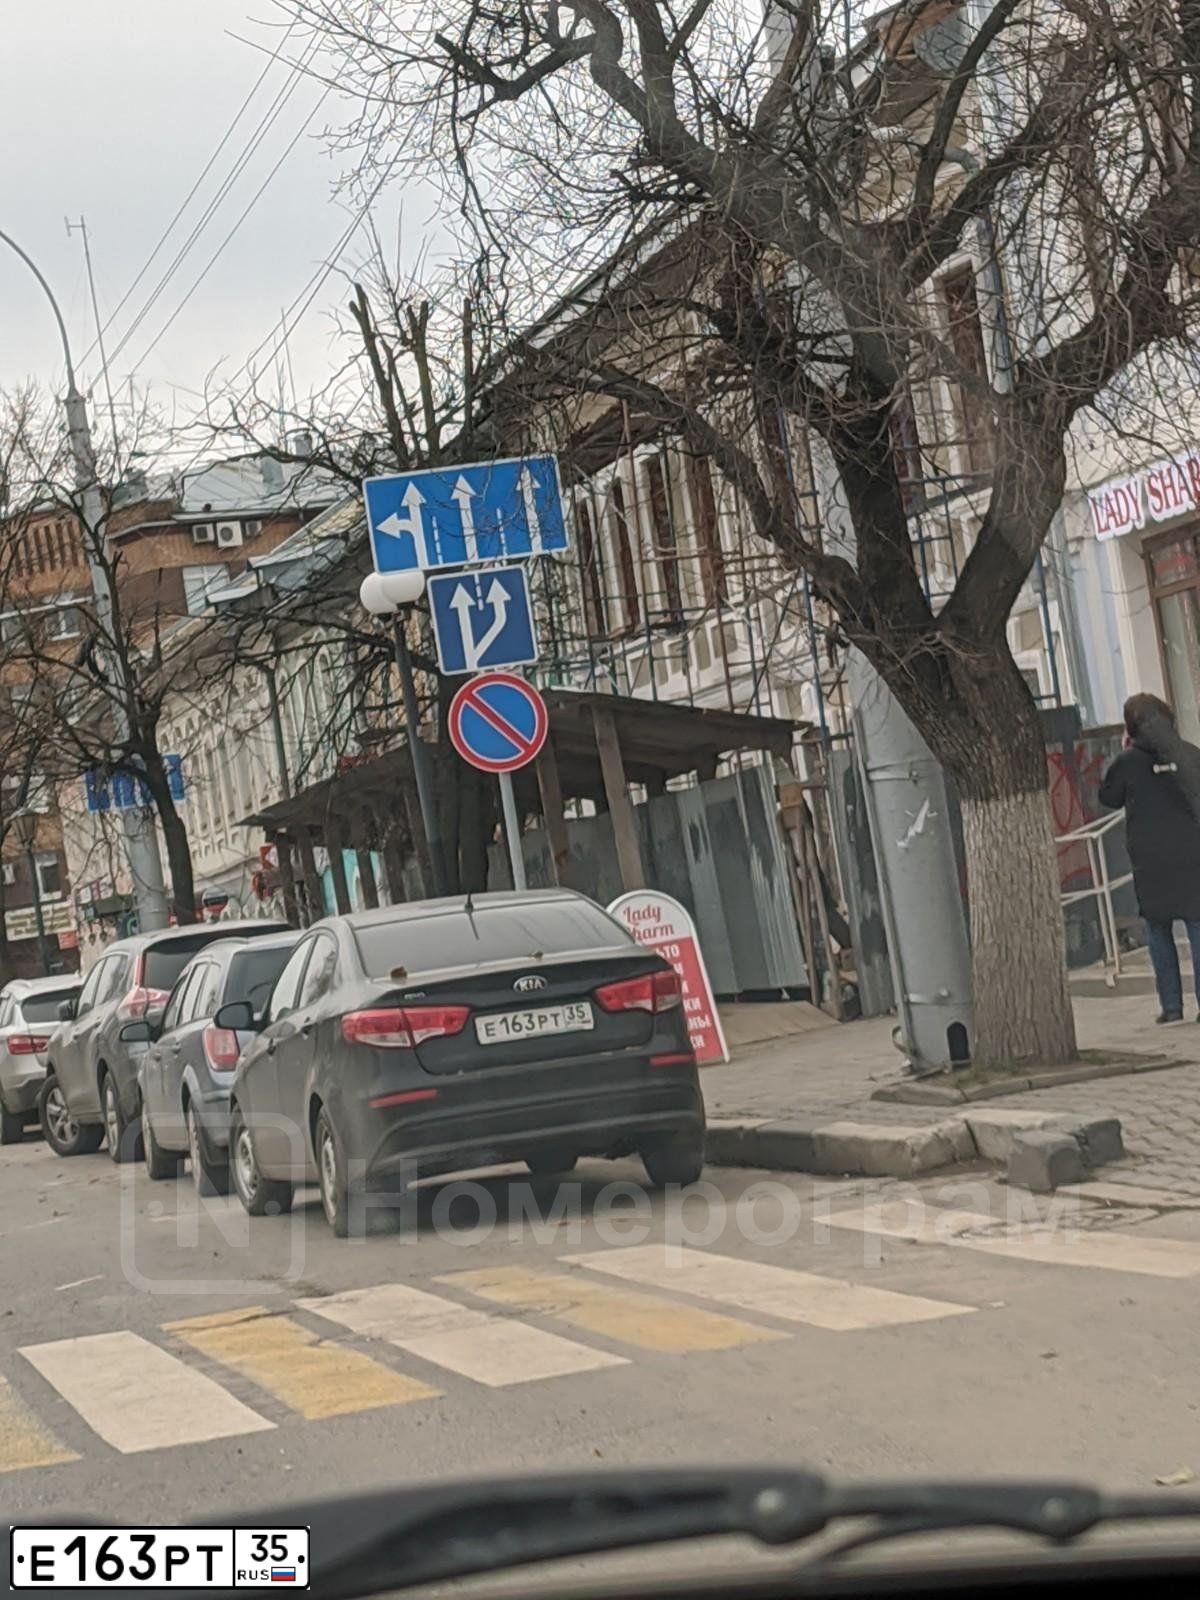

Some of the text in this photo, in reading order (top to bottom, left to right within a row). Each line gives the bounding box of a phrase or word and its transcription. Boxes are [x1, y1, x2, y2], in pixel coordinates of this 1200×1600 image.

[1091, 481, 1142, 534] LADY
[622, 904, 662, 926] Lady
[627, 924, 675, 941] harm
[518, 977, 545, 993] KIA
[484, 1005, 586, 1038] Е163РТ 35
